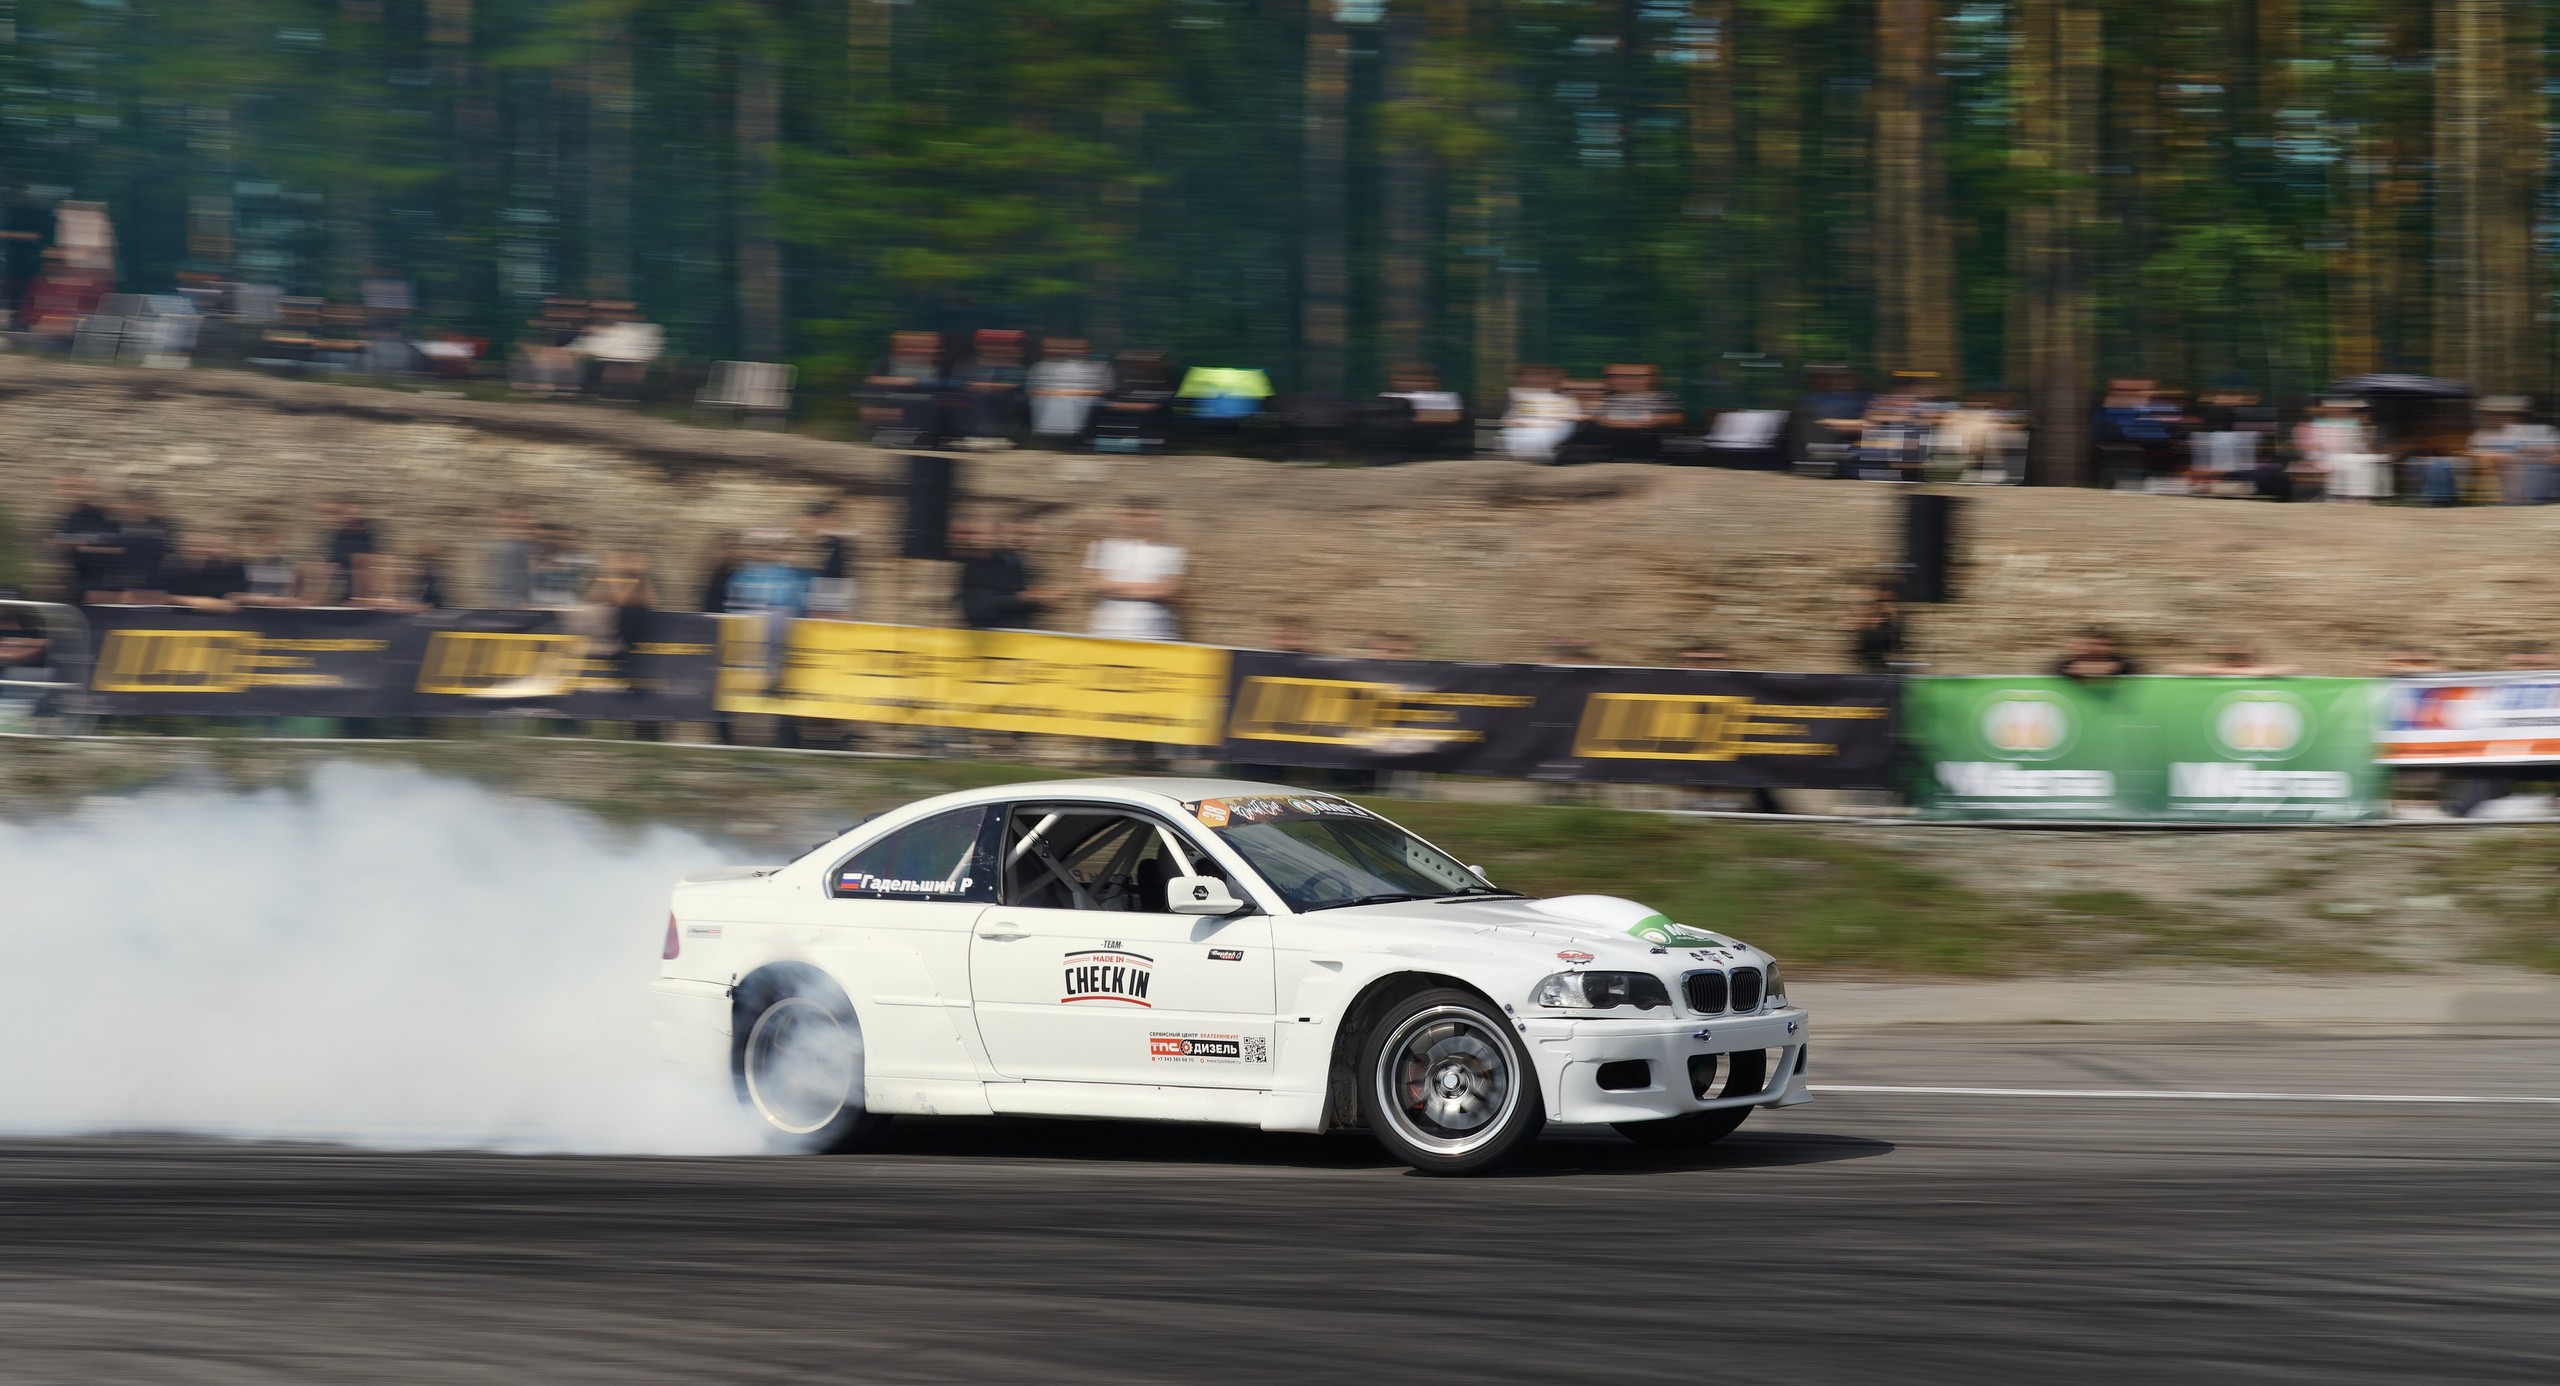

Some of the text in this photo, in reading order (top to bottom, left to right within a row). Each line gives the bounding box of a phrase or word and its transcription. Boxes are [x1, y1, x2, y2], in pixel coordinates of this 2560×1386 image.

[860, 874, 973, 893] Гадельшин Р
[1065, 965, 1150, 999] CHECK IN
[1194, 1043, 1238, 1055] ДИЗЕЛЬ
